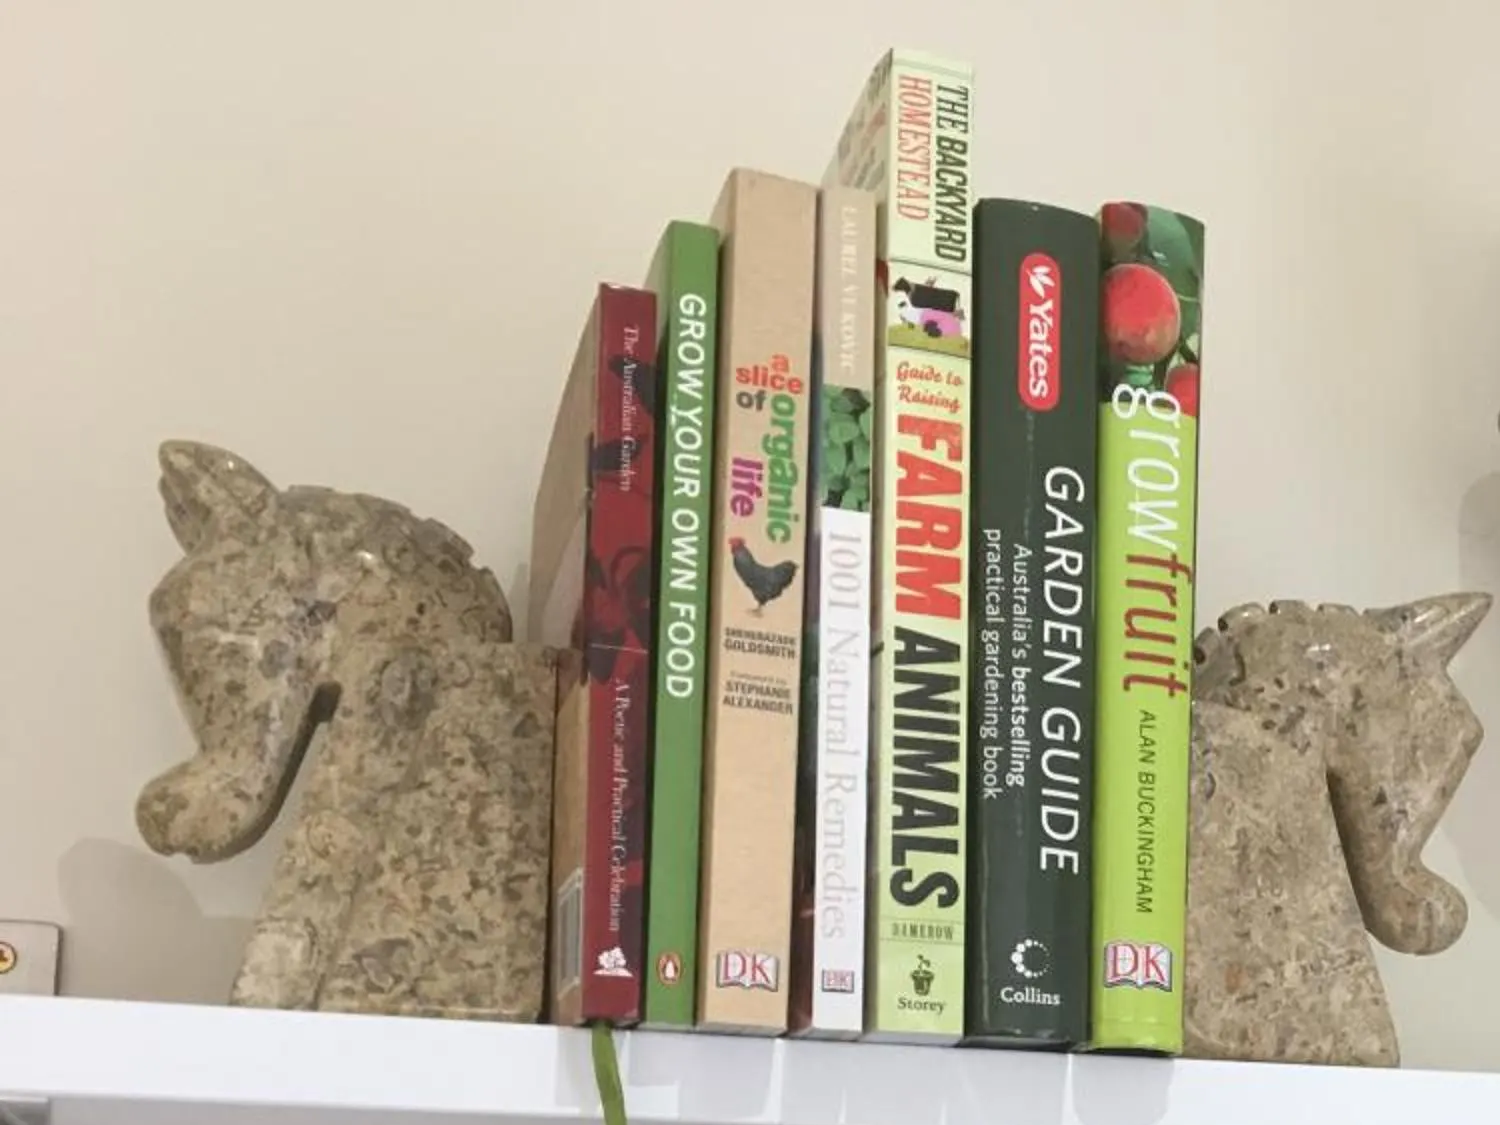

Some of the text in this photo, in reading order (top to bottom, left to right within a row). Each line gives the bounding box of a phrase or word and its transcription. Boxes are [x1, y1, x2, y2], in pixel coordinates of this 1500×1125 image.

[898, 74, 931, 221] HOMESTEAD
[935, 83, 968, 263] THE BACKYARD
[624, 323, 640, 354] The
[773, 354, 790, 373] a
[1029, 299, 1053, 399] Yates
[736, 365, 805, 395] slice
[737, 390, 767, 411] of
[897, 361, 963, 387] Guide to
[898, 384, 960, 412] Raising
[621, 435, 636, 492] Garden
[731, 456, 764, 517] life
[762, 393, 800, 544] organic
[668, 293, 706, 698] GROW YOUR OWN FOOD
[827, 626, 861, 758] Natural
[890, 414, 963, 909] FARM ANIMALS
[981, 528, 1005, 800] practical gardening book
[1006, 543, 1033, 787] Australia's bestselling
[1040, 466, 1085, 875] GARDEN GUIDE
[723, 694, 794, 715] ALEXANDER
[613, 742, 629, 773] and
[612, 776, 629, 841] Practical
[1136, 709, 1156, 913] ALAN BUCKINGHAM
[821, 771, 858, 939] Remedies
[609, 844, 627, 933] Celebration
[720, 952, 773, 984] DK
[1111, 943, 1166, 982] DK
[897, 996, 946, 1016] Storey
[1000, 986, 1061, 1007] Collins
